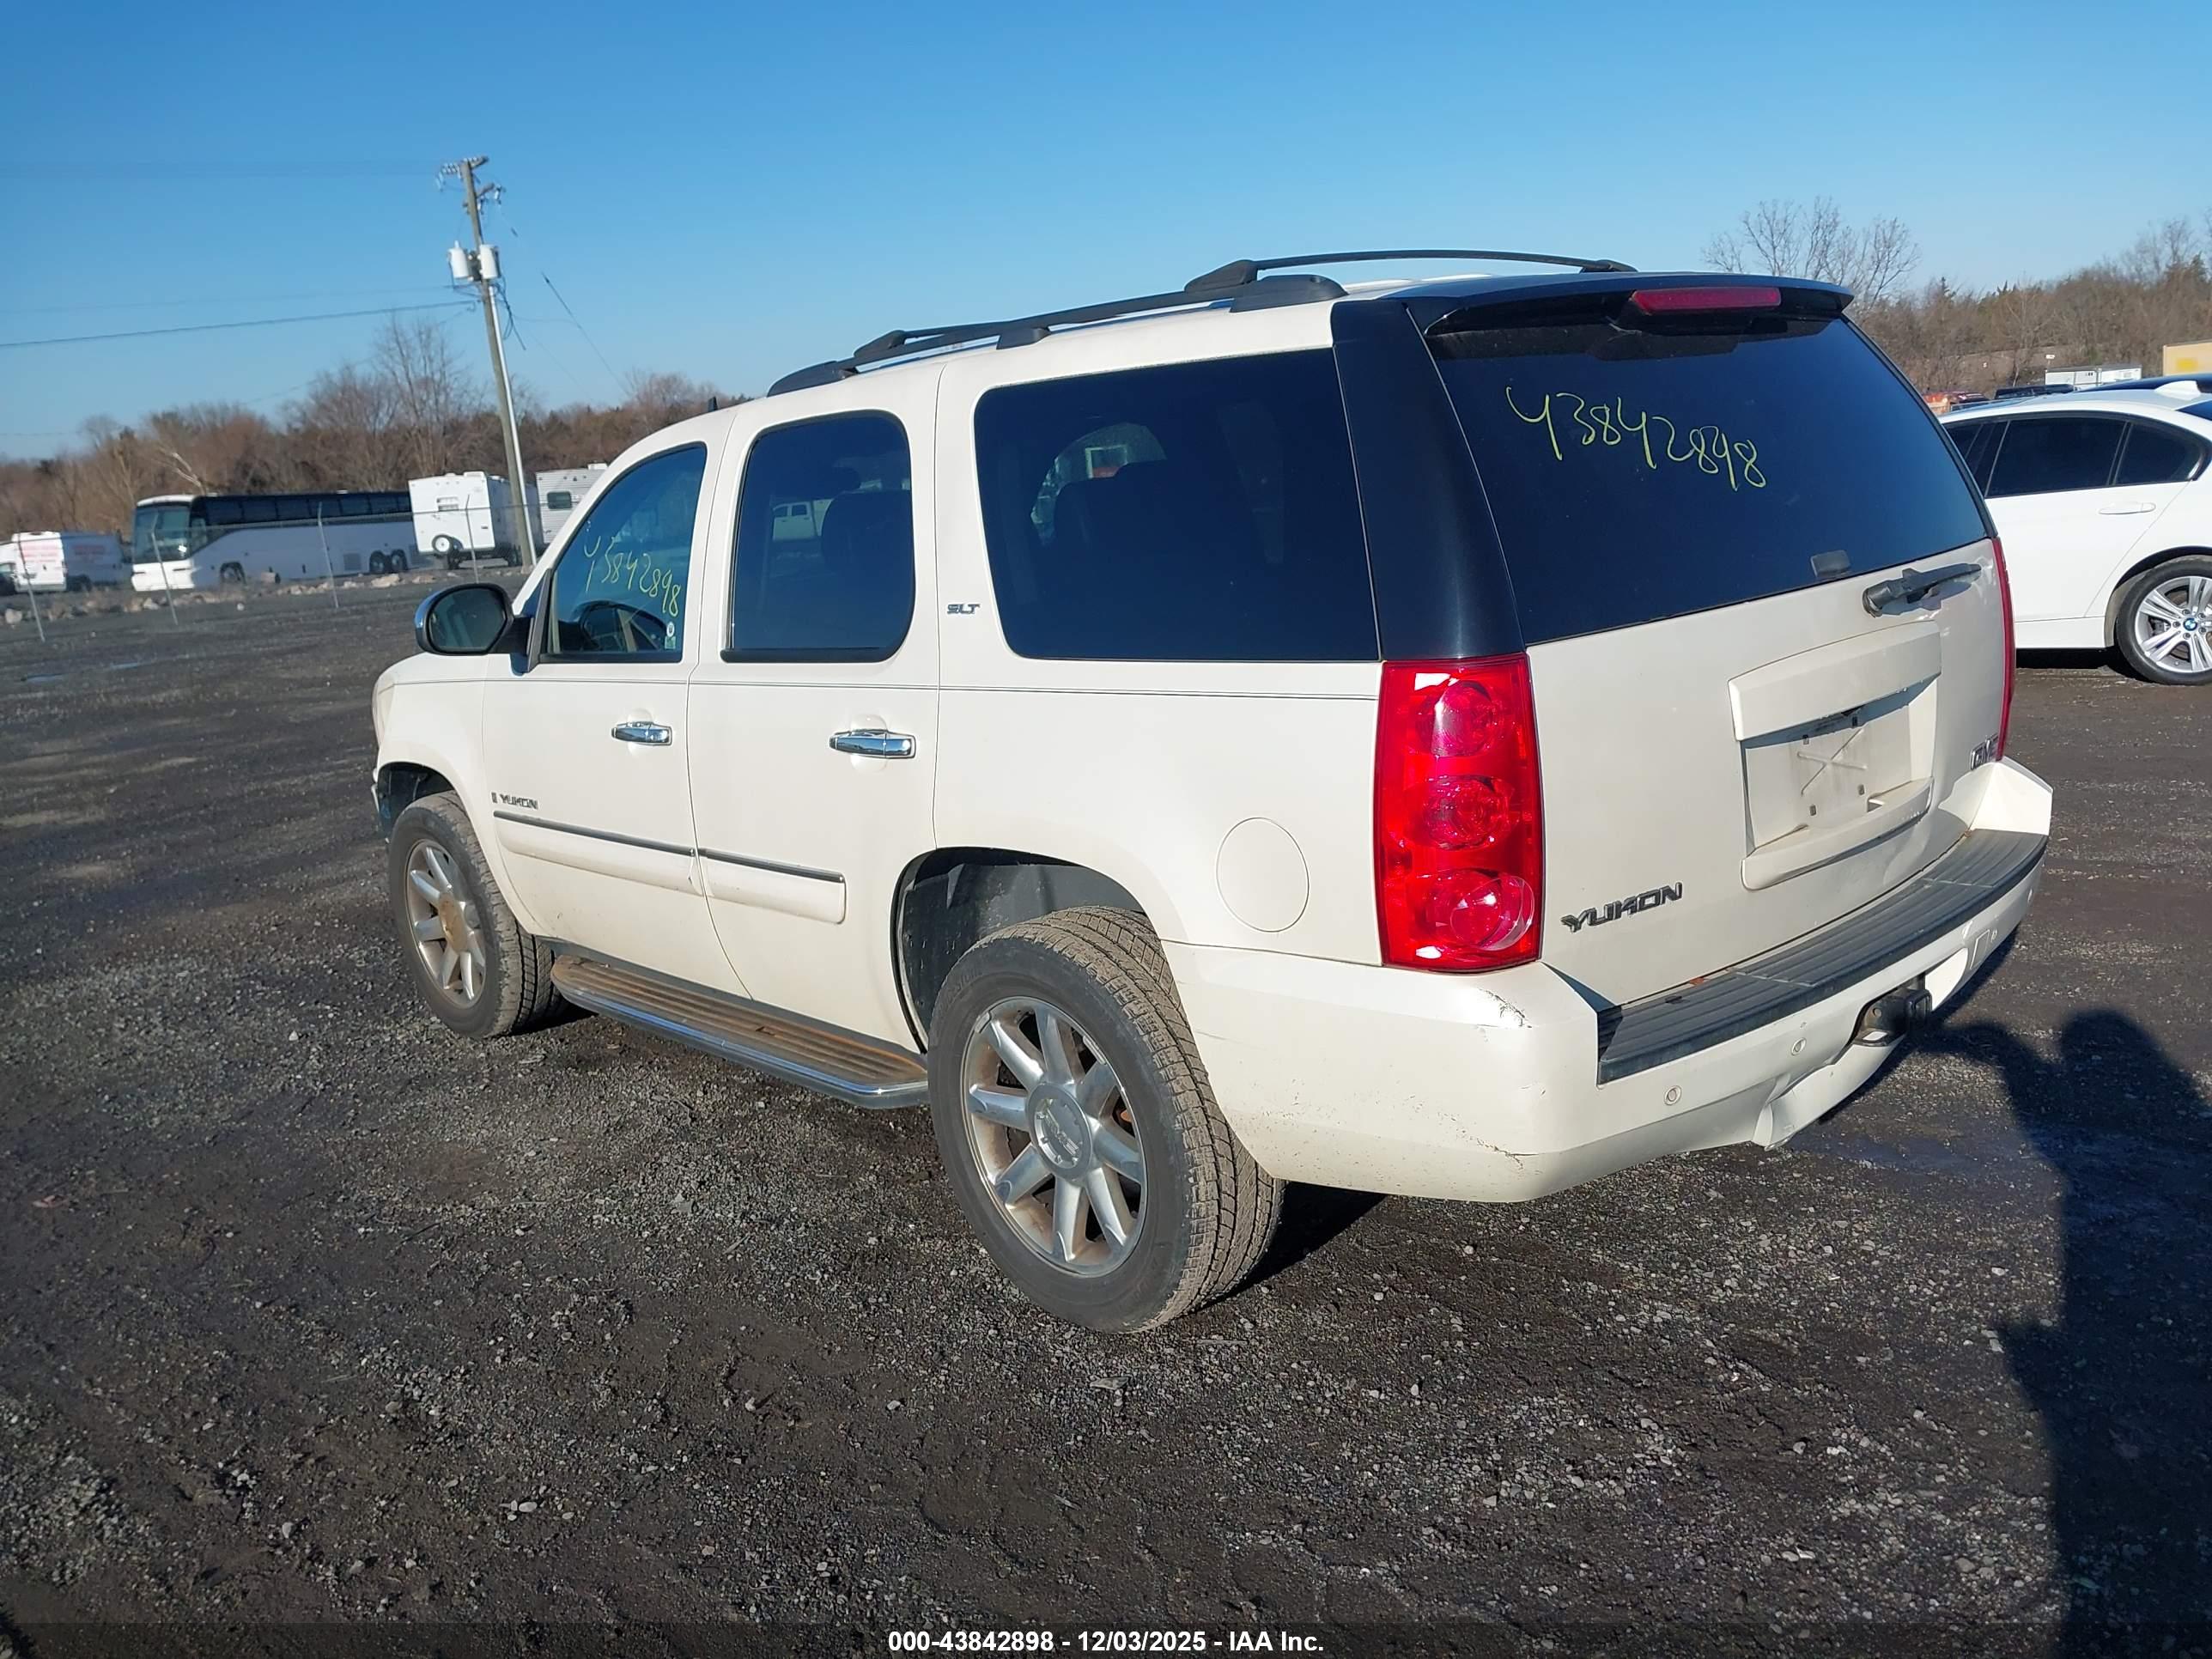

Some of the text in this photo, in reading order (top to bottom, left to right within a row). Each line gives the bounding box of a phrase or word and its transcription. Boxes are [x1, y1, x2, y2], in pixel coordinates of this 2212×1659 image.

[1505, 386, 1766, 491] 43842898
[946, 603, 981, 615] SLT
[500, 793, 538, 810] YUKON
[1560, 882, 1683, 933] YUKON
